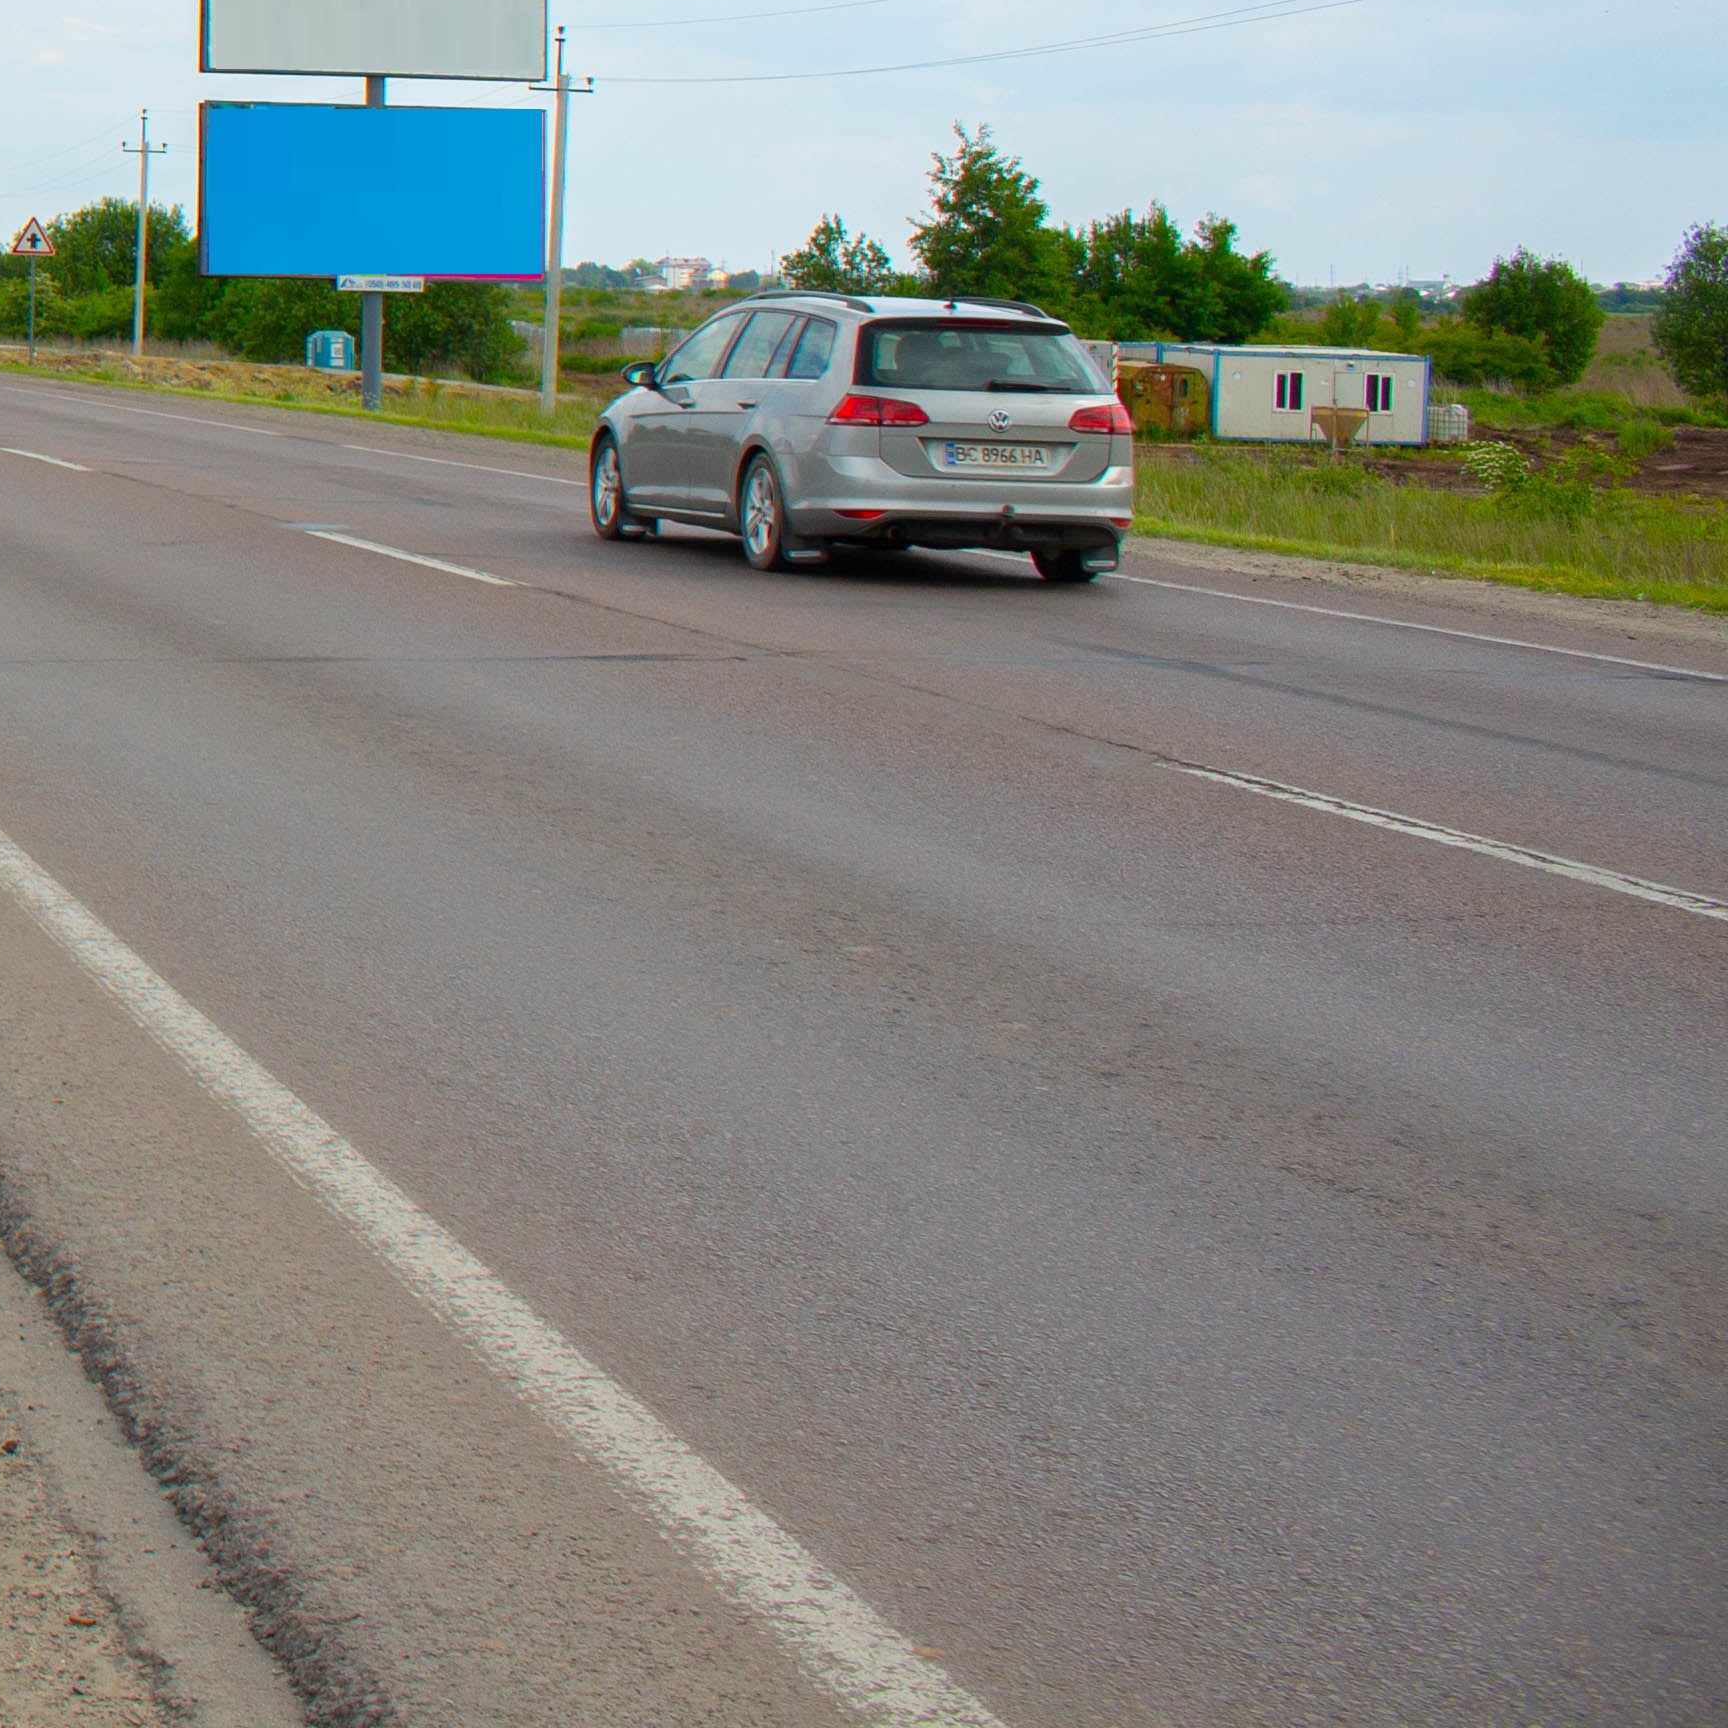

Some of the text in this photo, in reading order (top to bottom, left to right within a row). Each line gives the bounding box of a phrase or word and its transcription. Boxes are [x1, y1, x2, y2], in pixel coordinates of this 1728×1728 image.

[955, 446, 1044, 465] BC 8966 HA
